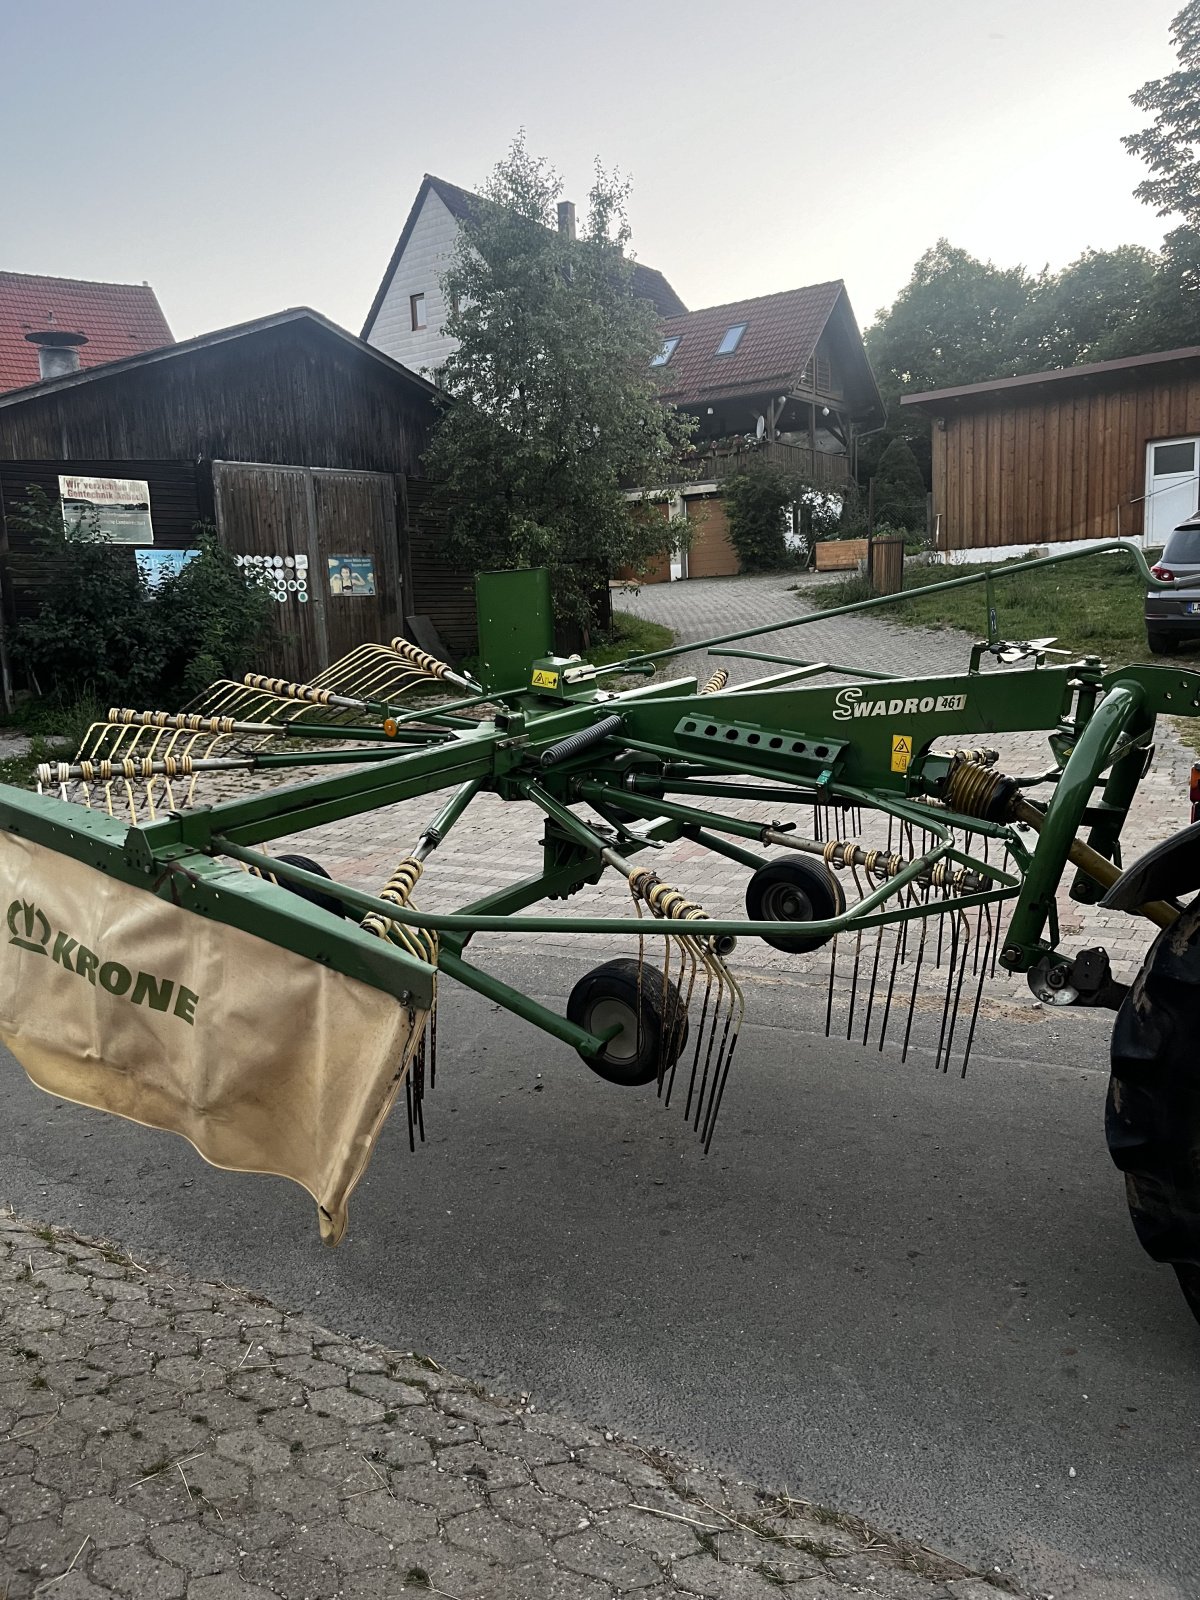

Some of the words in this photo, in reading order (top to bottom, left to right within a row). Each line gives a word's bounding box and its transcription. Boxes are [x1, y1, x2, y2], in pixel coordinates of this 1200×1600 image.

[66, 480, 80, 489] Wir
[67, 489, 114, 499] Gentechnik
[832, 687, 935, 721] SWADRO
[941, 696, 962, 709] 461
[52, 930, 200, 1027] KRONE
